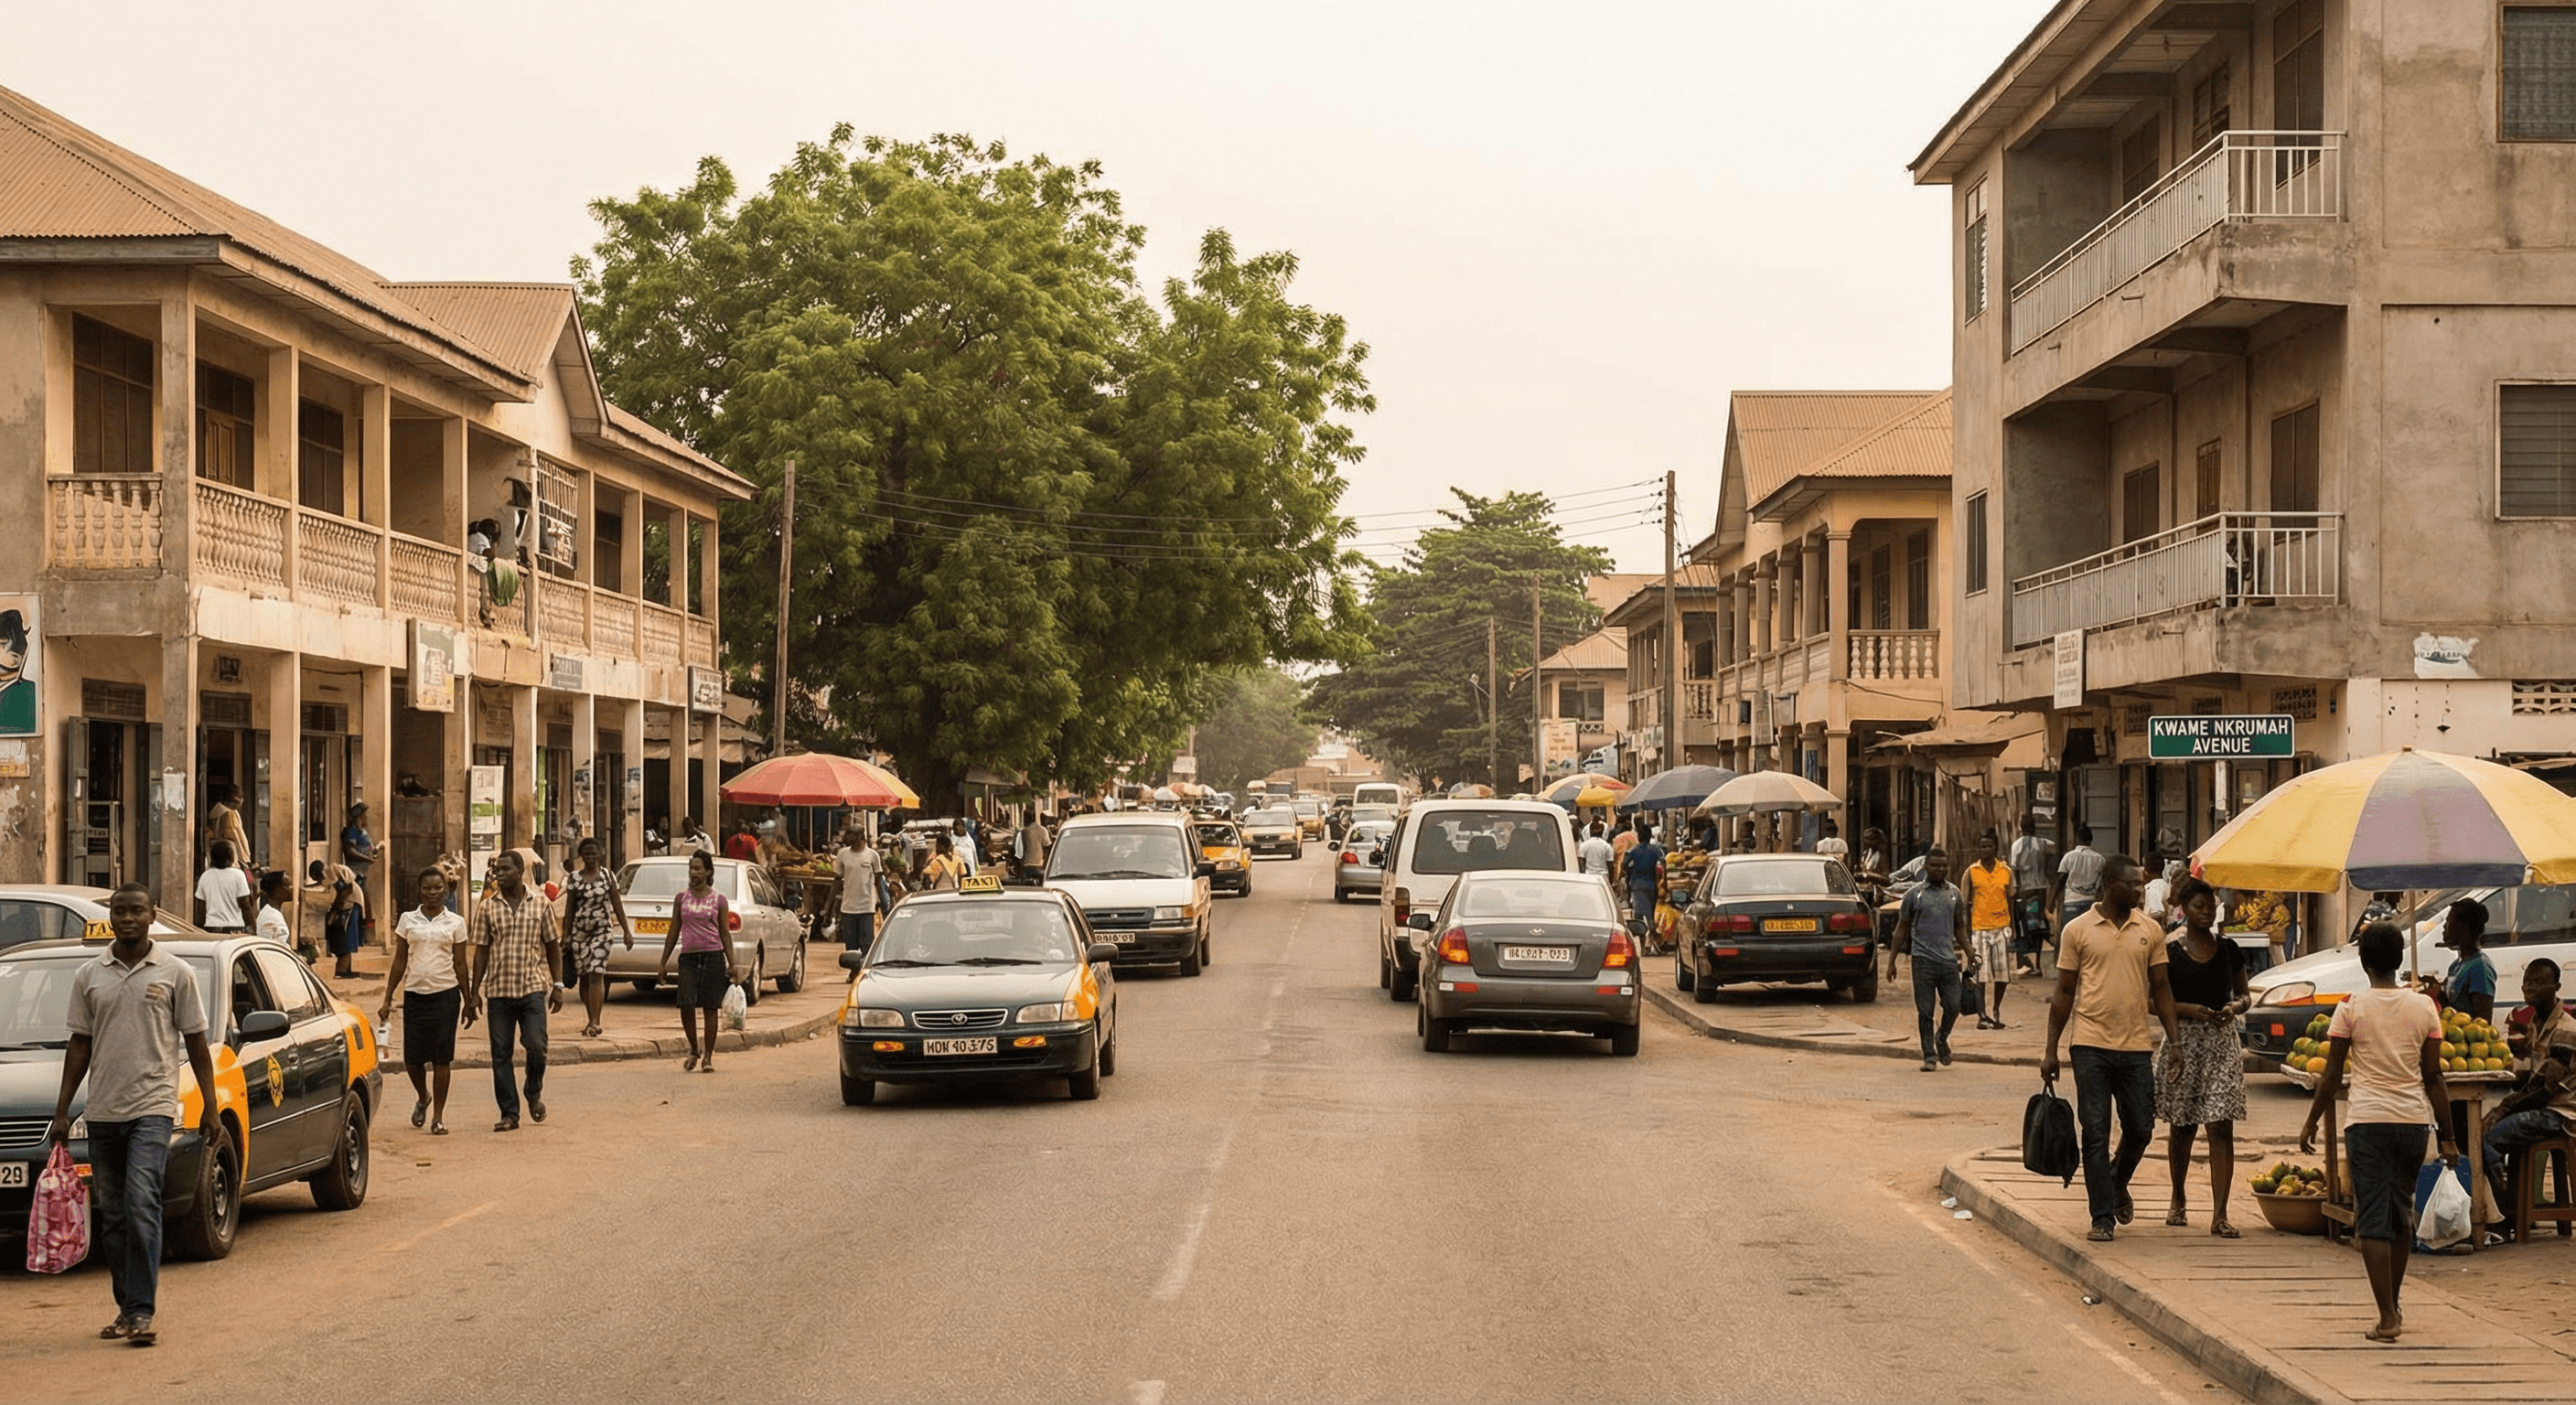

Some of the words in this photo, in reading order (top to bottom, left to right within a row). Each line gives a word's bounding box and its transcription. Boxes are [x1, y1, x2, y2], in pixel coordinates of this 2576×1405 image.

[2154, 720, 2209, 736] KWAME
[2215, 719, 2288, 735] NKRUMAH
[2192, 737, 2250, 754] AVENUE
